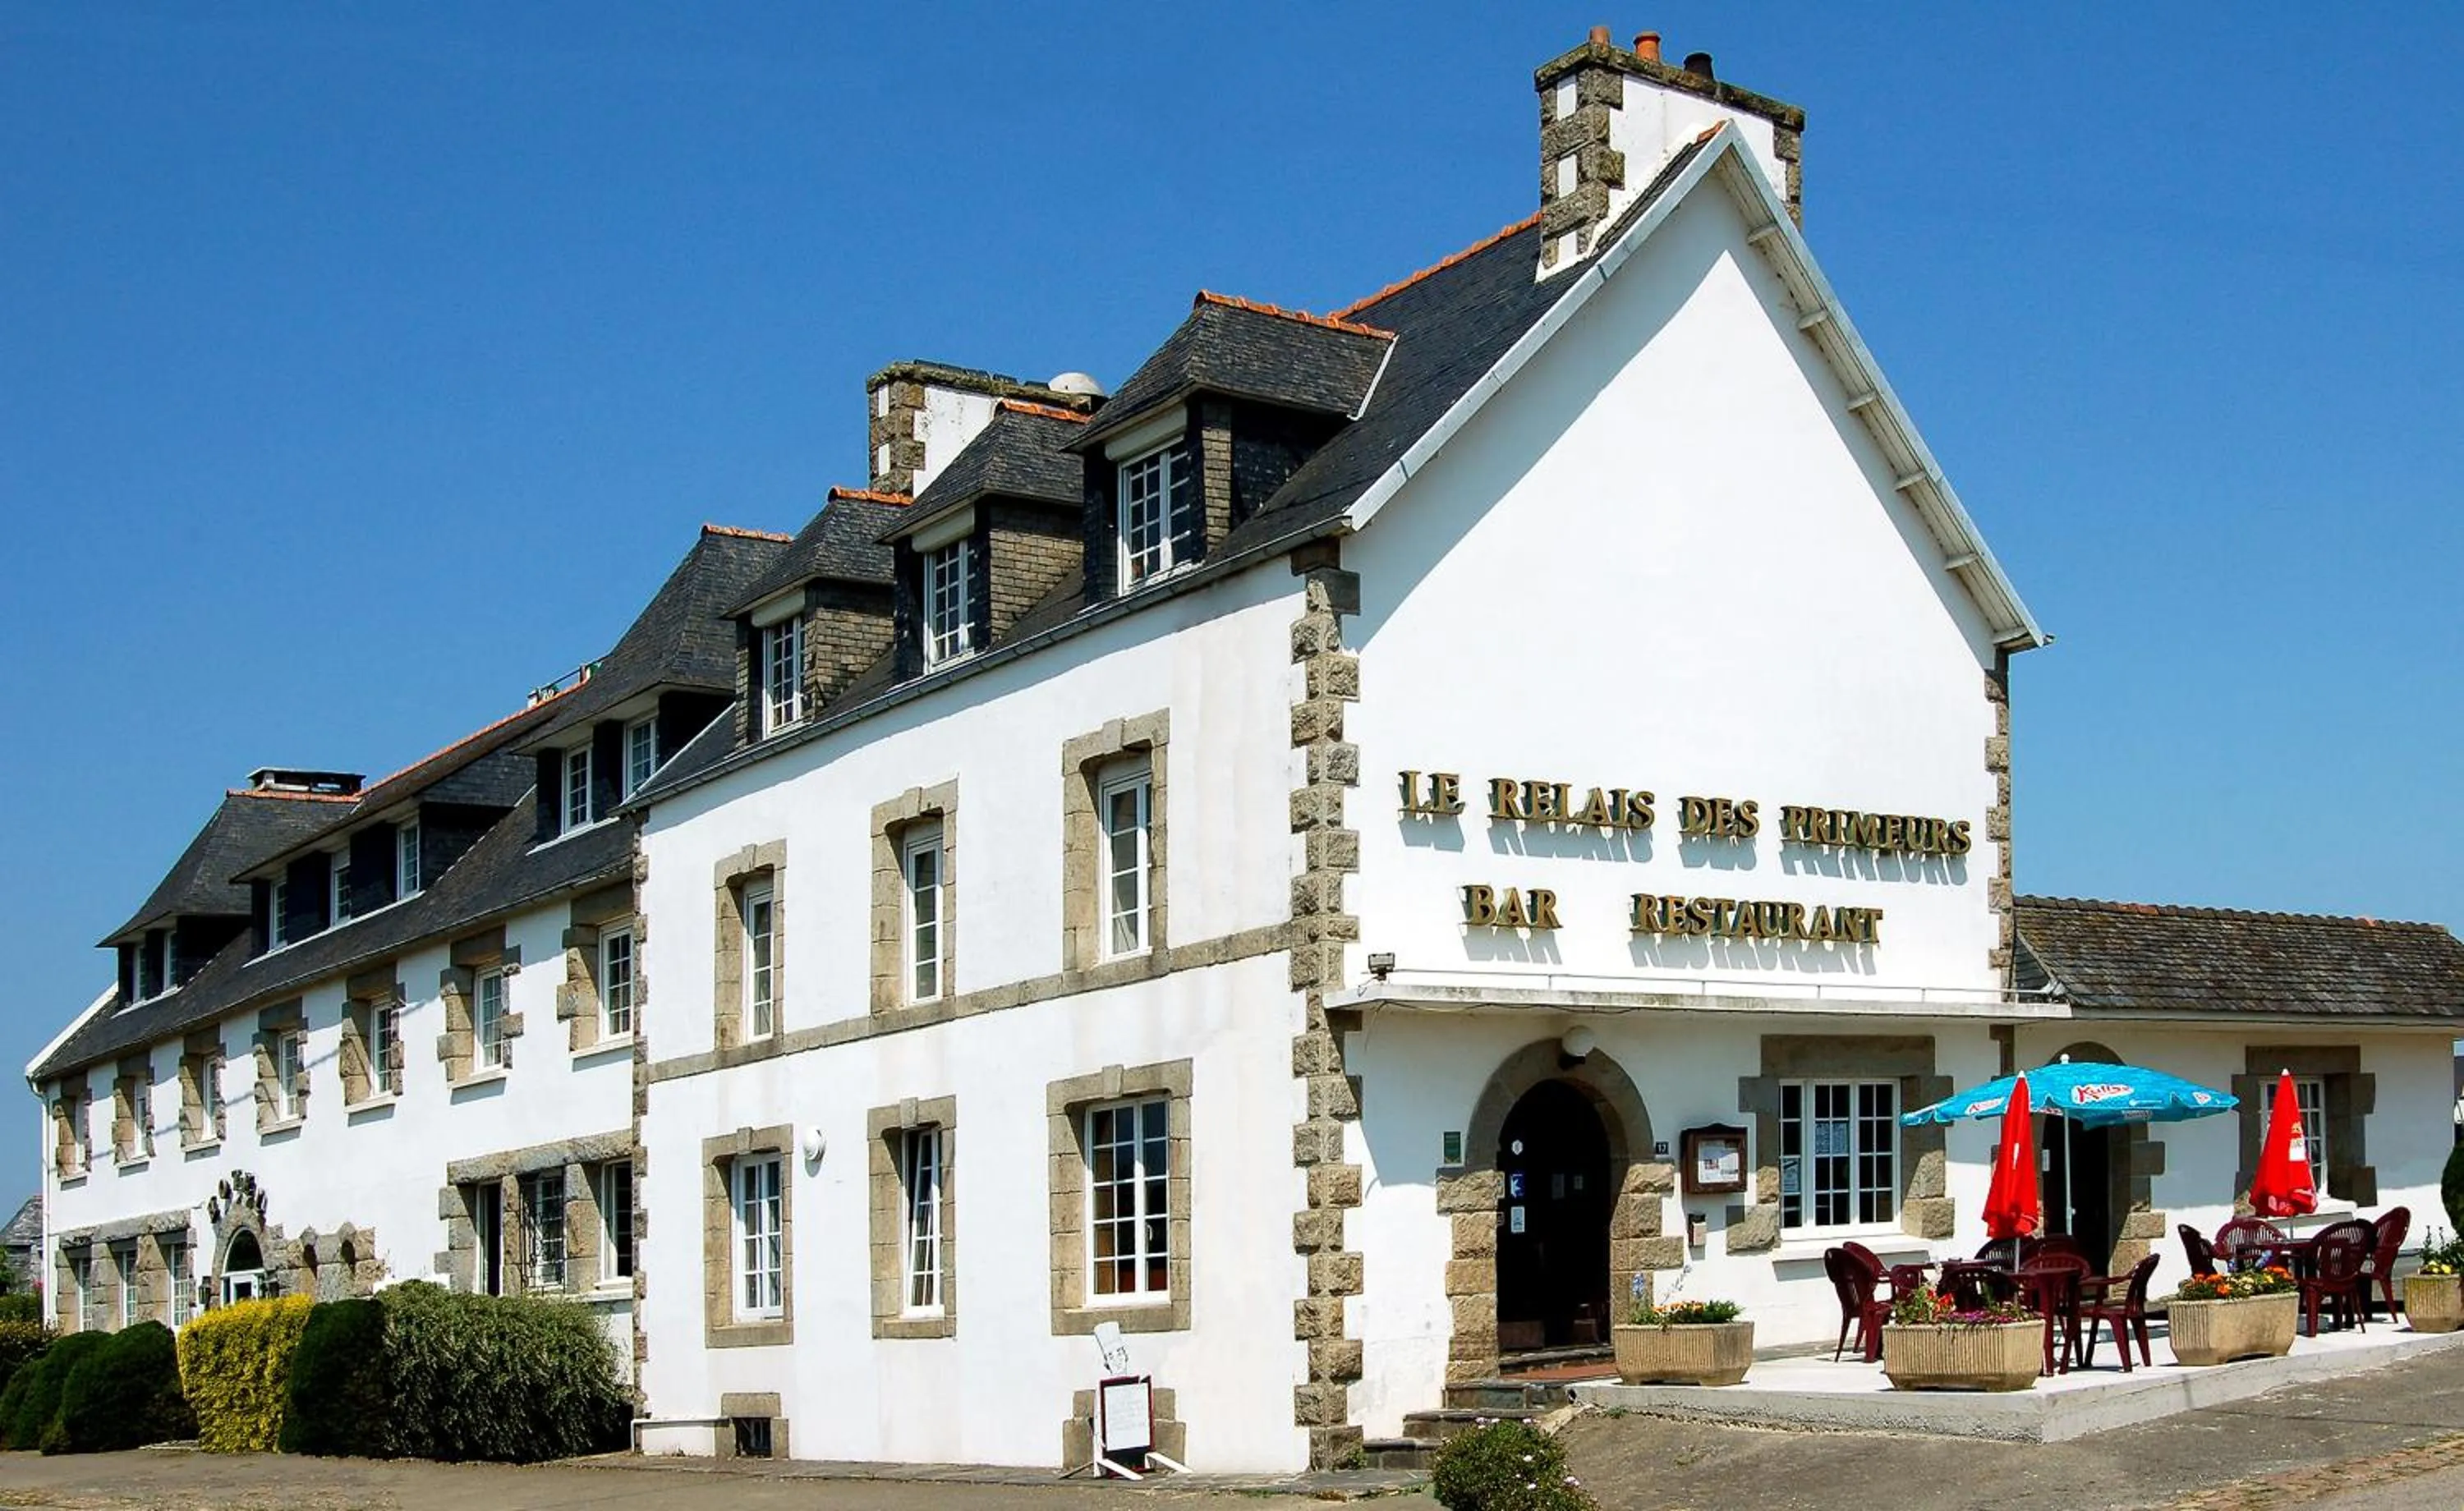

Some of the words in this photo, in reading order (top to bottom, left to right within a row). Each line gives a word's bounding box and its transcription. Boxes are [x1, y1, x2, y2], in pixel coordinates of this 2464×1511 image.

[1399, 771, 1465, 815] LE
[1487, 778, 1655, 829] RELAIS
[1679, 797, 1759, 838] DES
[1781, 806, 1971, 855] PRIMEURS
[1460, 884, 1563, 929] BAR
[1630, 893, 1882, 944] RESTAURANT
